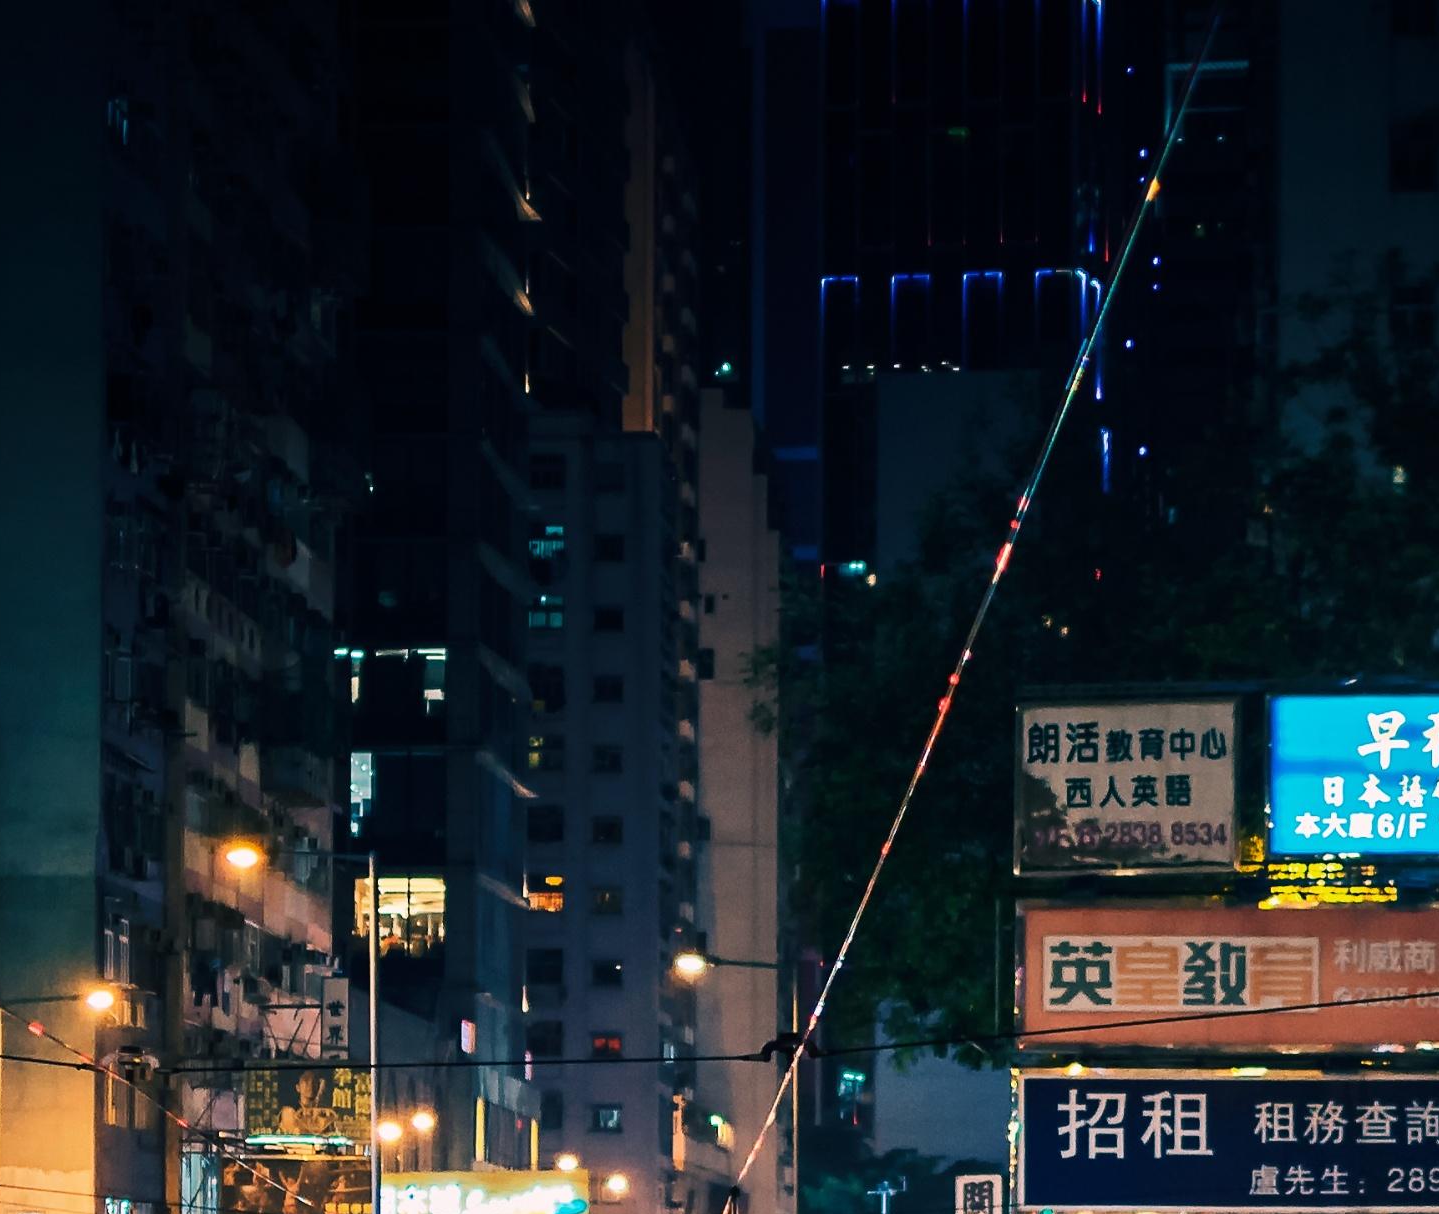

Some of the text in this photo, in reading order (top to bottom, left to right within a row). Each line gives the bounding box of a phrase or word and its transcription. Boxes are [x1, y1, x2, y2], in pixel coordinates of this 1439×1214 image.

[1027, 721, 1227, 764] 朗活教育中心
[1065, 774, 1192, 808] 西人英語
[1171, 822, 1228, 847] 8534
[1057, 1088, 1214, 1160] 招租
